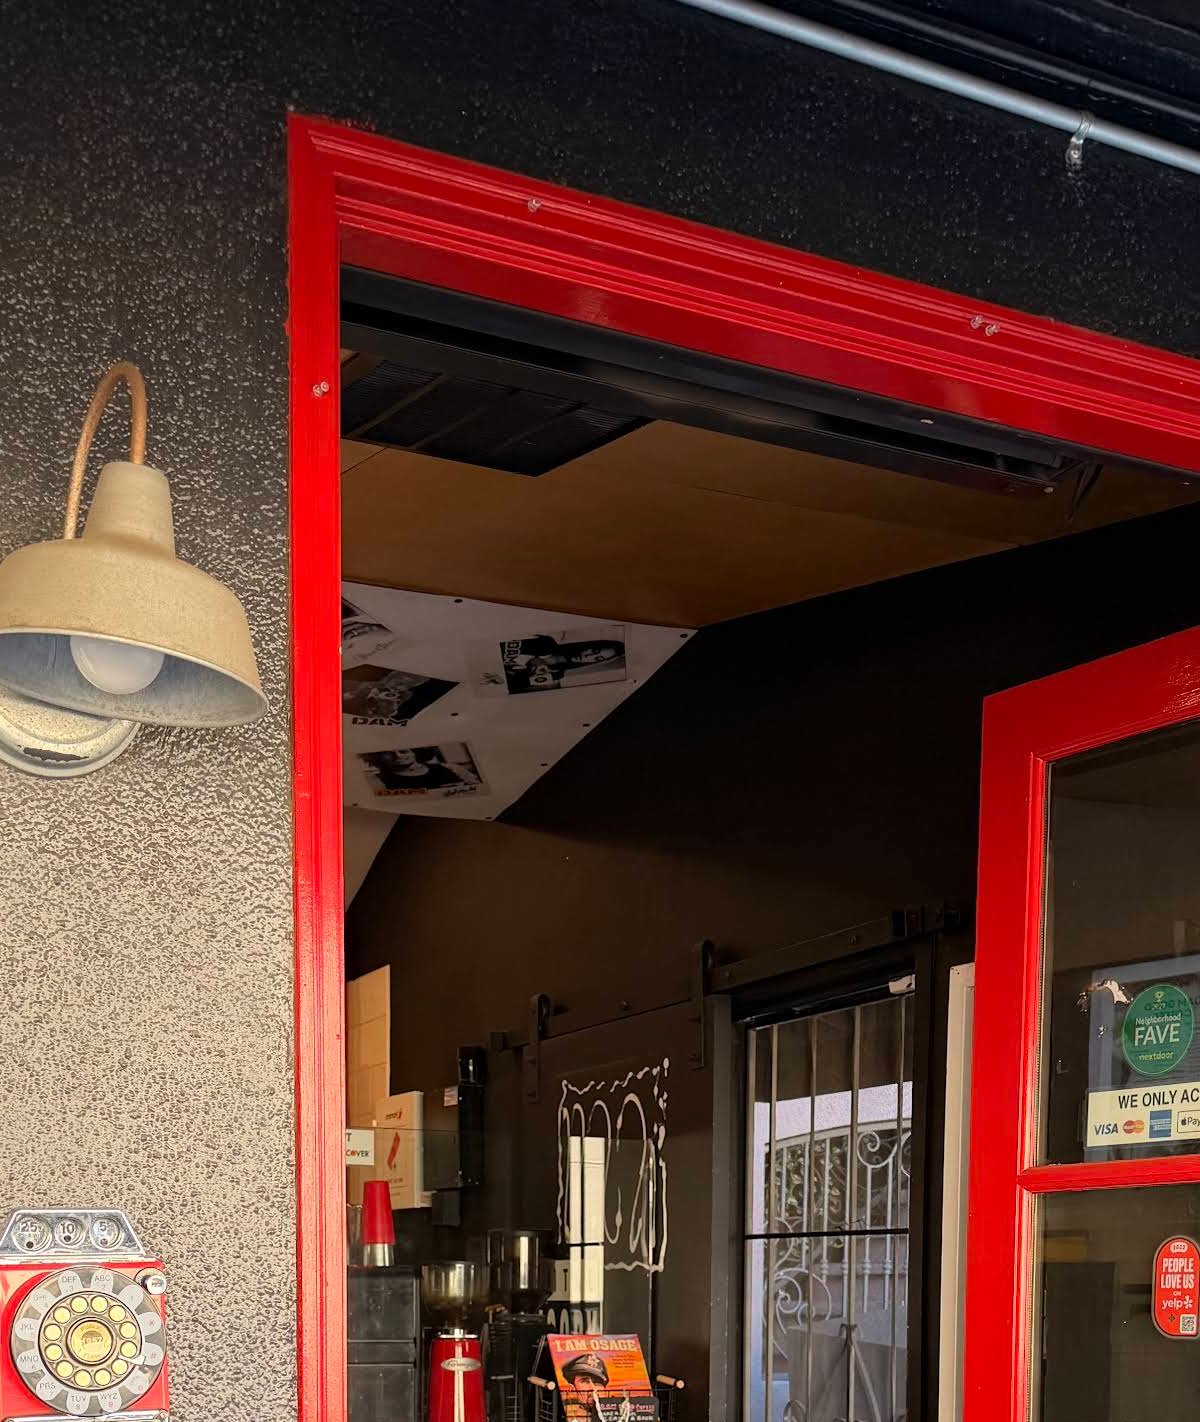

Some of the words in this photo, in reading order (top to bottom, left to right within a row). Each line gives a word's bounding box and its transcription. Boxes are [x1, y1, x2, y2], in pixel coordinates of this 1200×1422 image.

[352, 717, 408, 727] DAM
[1135, 1013, 1182, 1026] Neighborhood
[1134, 1023, 1181, 1047] FAVE
[1139, 1051, 1174, 1061] nextdoor
[1118, 1094, 1138, 1109] WE
[1142, 1090, 1178, 1107] ONLY
[1093, 1123, 1119, 1136] VISA
[21, 1221, 38, 1233] 25
[60, 1222, 75, 1234] 10
[99, 1221, 107, 1232] 5
[1162, 1257, 1194, 1273] PEOPLE
[62, 1276, 78, 1284] DEF
[94, 1274, 111, 1282] ABC
[1160, 1274, 1182, 1289] LOVE
[1182, 1274, 1194, 1289] US
[1162, 1298, 1183, 1309] yelp
[554, 1339, 562, 1352] I
[565, 1339, 588, 1352] AM
[590, 1338, 638, 1351] OSAGE
[19, 1355, 39, 1363] MNO
[39, 1381, 56, 1390] PRS
